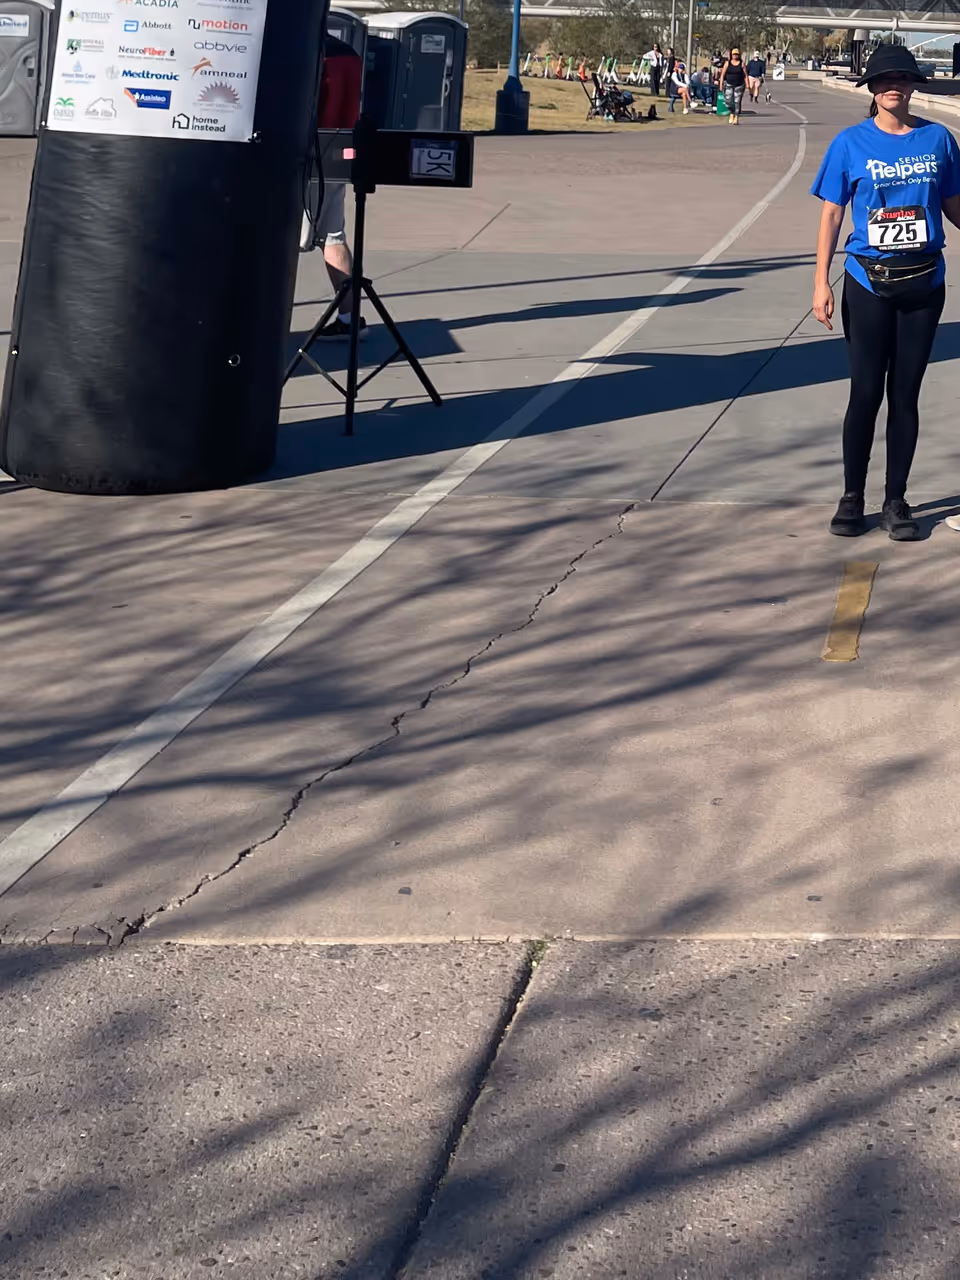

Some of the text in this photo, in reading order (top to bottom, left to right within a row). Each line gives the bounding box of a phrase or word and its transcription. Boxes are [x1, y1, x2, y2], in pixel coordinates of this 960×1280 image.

[141, 21, 173, 30] Abbott
[194, 40, 247, 53] abbvie
[122, 69, 180, 81] Medtronic
[200, 70, 248, 79] amneal
[192, 115, 219, 124] home
[191, 124, 226, 132] instead
[426, 149, 451, 174] 5K
[898, 154, 936, 165] SENIOR
[869, 161, 938, 180] Helpers
[908, 176, 921, 184] Only
[878, 222, 918, 244] 725
